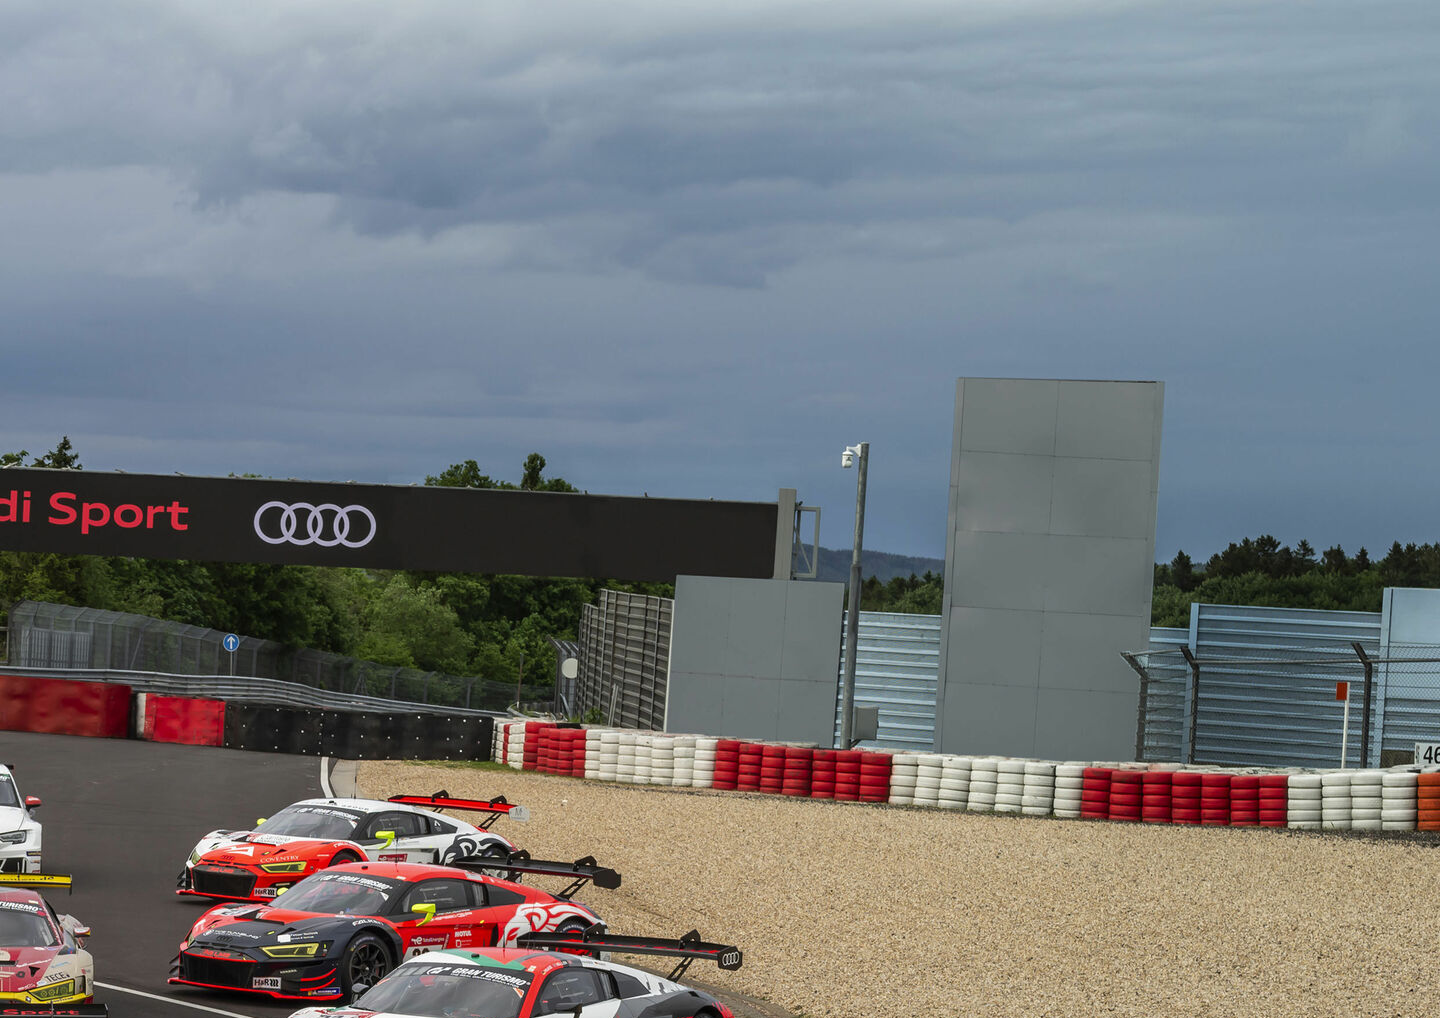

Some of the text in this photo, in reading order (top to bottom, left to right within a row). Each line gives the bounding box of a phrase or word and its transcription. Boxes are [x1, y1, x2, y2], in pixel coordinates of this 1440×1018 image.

[49, 492, 189, 535] Sport
[260, 854, 300, 863] COVENTRY
[452, 967, 480, 977] GRAN
[481, 971, 526, 987] TURISMO
